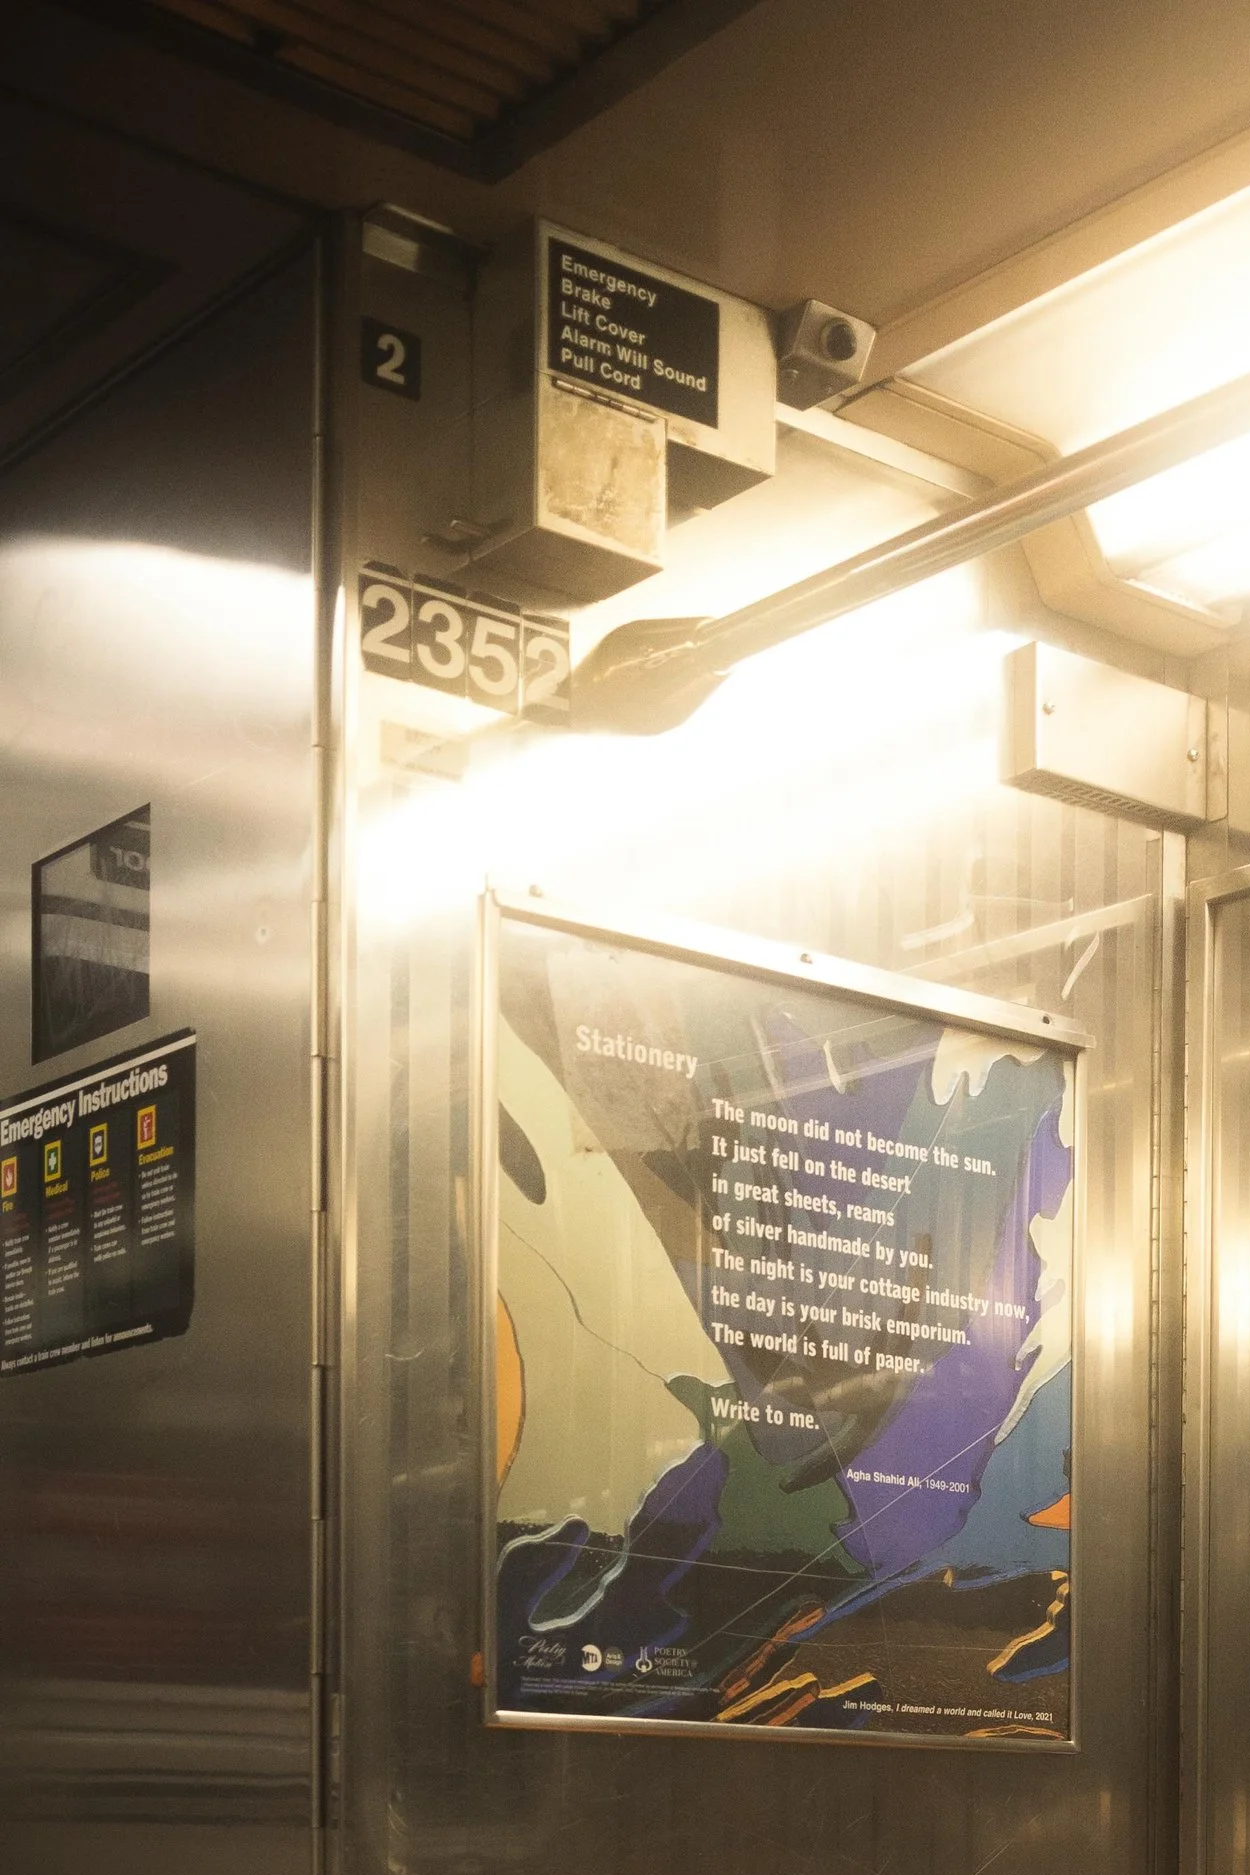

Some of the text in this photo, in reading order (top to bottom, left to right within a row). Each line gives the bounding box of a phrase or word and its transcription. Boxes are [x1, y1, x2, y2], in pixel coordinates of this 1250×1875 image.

[561, 254, 657, 307] Emergency
[561, 278, 611, 310] Brake
[561, 301, 646, 345] Lift Cover
[376, 333, 407, 386] 2
[561, 325, 706, 392] Alarm Will Sound
[561, 348, 641, 390] Pull Cord
[361, 584, 570, 712] 2352
[576, 1024, 698, 1079] Stationery
[0, 1064, 168, 1147] Emergency Instructions
[712, 1098, 996, 1176] The moon did not become the sun.
[712, 1135, 911, 1195] It just fell on the desert
[712, 1173, 895, 1226] in great sheets, reams
[712, 1212, 933, 1269] of silver handmade by you.
[712, 1247, 1030, 1325] The night is your cottage industry now,
[712, 1285, 971, 1346] the day is your brisk emporium.
[712, 1322, 925, 1374] The world is full of paper.
[711, 1397, 820, 1430] Write to me.
[846, 1468, 970, 1493] Agha Shahid Ali, 1949-2001
[581, 1651, 598, 1665] MTA
[654, 1646, 688, 1656] POETRY
[655, 1668, 694, 1678] AMERICA
[842, 1700, 857, 1710] Jim
[860, 1701, 894, 1713] Hodges,
[901, 1704, 935, 1714] dreamed
[943, 1706, 966, 1716] world
[967, 1708, 982, 1717] and
[983, 1709, 1006, 1718] called
[1006, 1710, 1013, 1719] it
[1014, 1710, 1034, 1721] Love,
[1035, 1712, 1053, 1721] 2021
